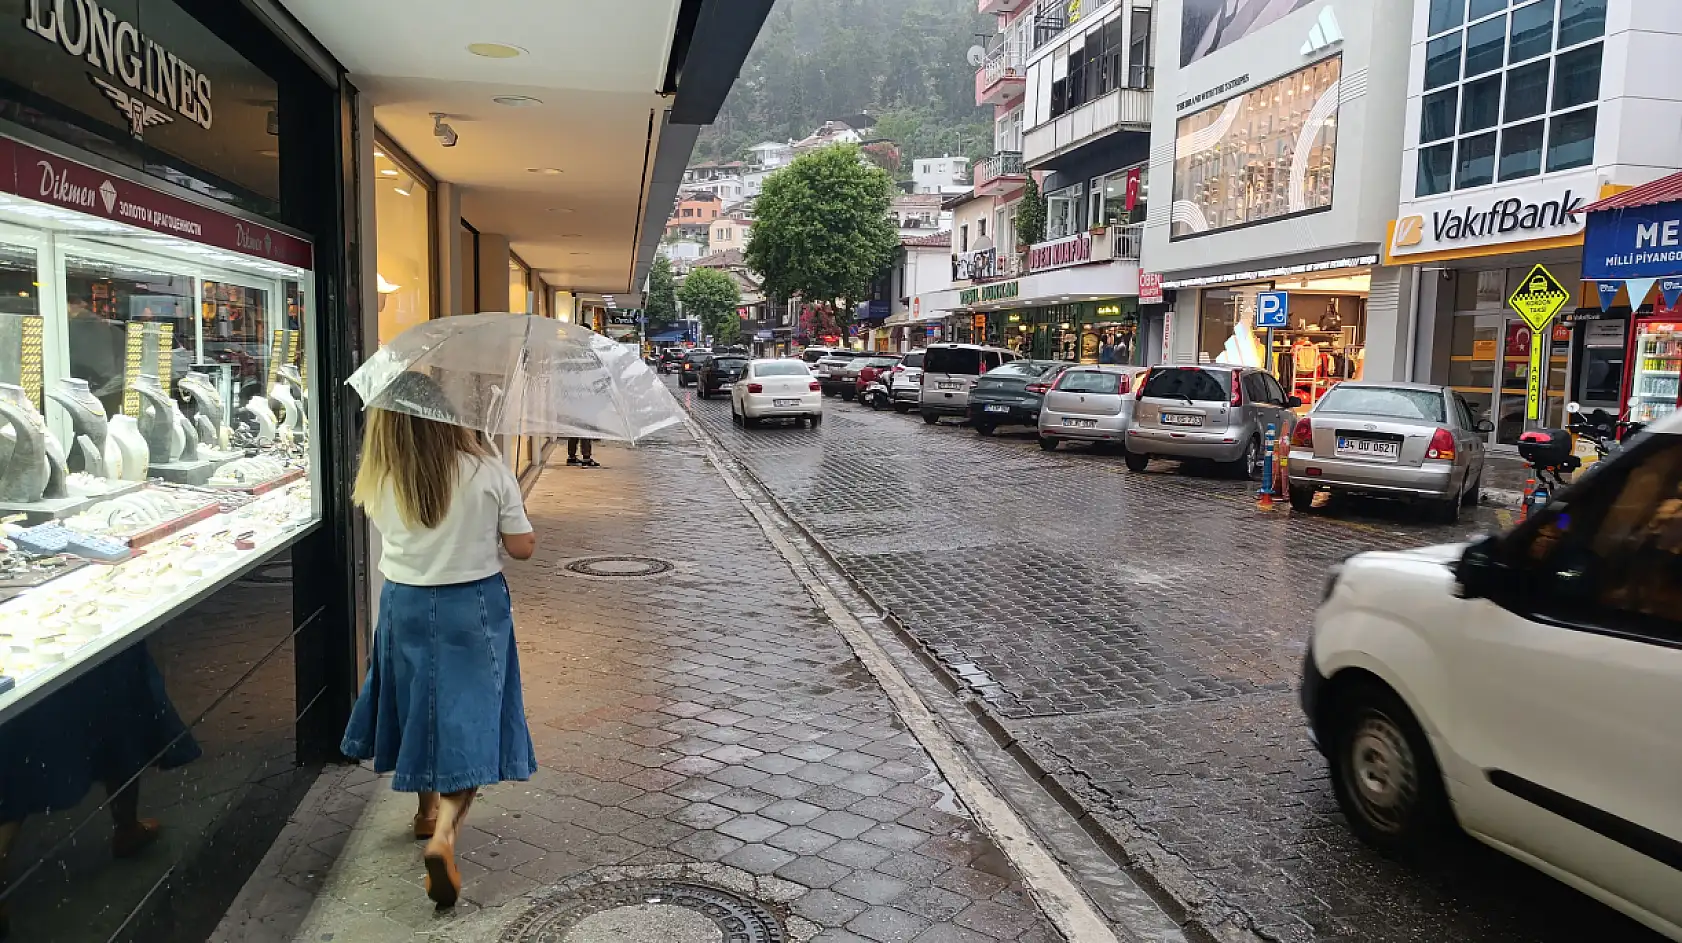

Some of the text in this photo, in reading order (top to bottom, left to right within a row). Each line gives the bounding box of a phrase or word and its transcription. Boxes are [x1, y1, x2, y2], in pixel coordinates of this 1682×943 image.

[37, 160, 95, 208] Dikmen
[119, 201, 147, 220] ЗОЛОТО
[1432, 189, 1584, 242] VakıfBank
[1635, 219, 1680, 249] ME
[1605, 251, 1682, 266] MİLLİ PİYANGO
[1259, 295, 1280, 323] P
